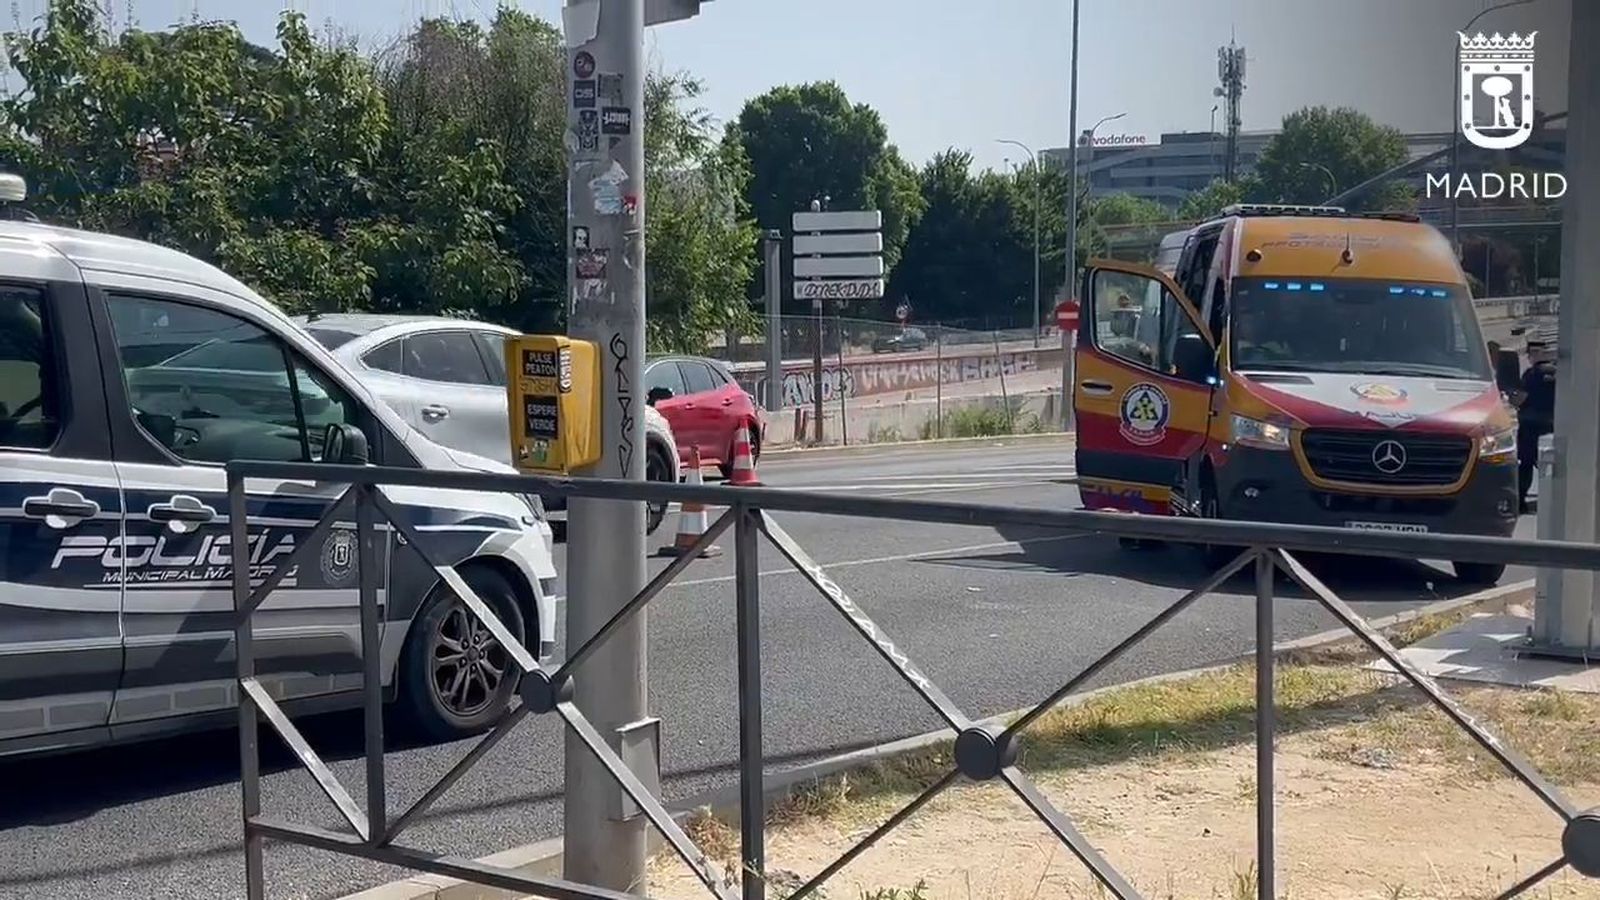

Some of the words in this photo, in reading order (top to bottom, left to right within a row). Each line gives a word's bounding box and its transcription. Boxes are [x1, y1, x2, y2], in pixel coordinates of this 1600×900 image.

[1093, 134, 1146, 145] vodafone
[528, 352, 552, 363] PULSE
[527, 404, 557, 416] ESPERE
[529, 418, 556, 430] VERDE
[102, 570, 202, 583] MUNICIPAL
